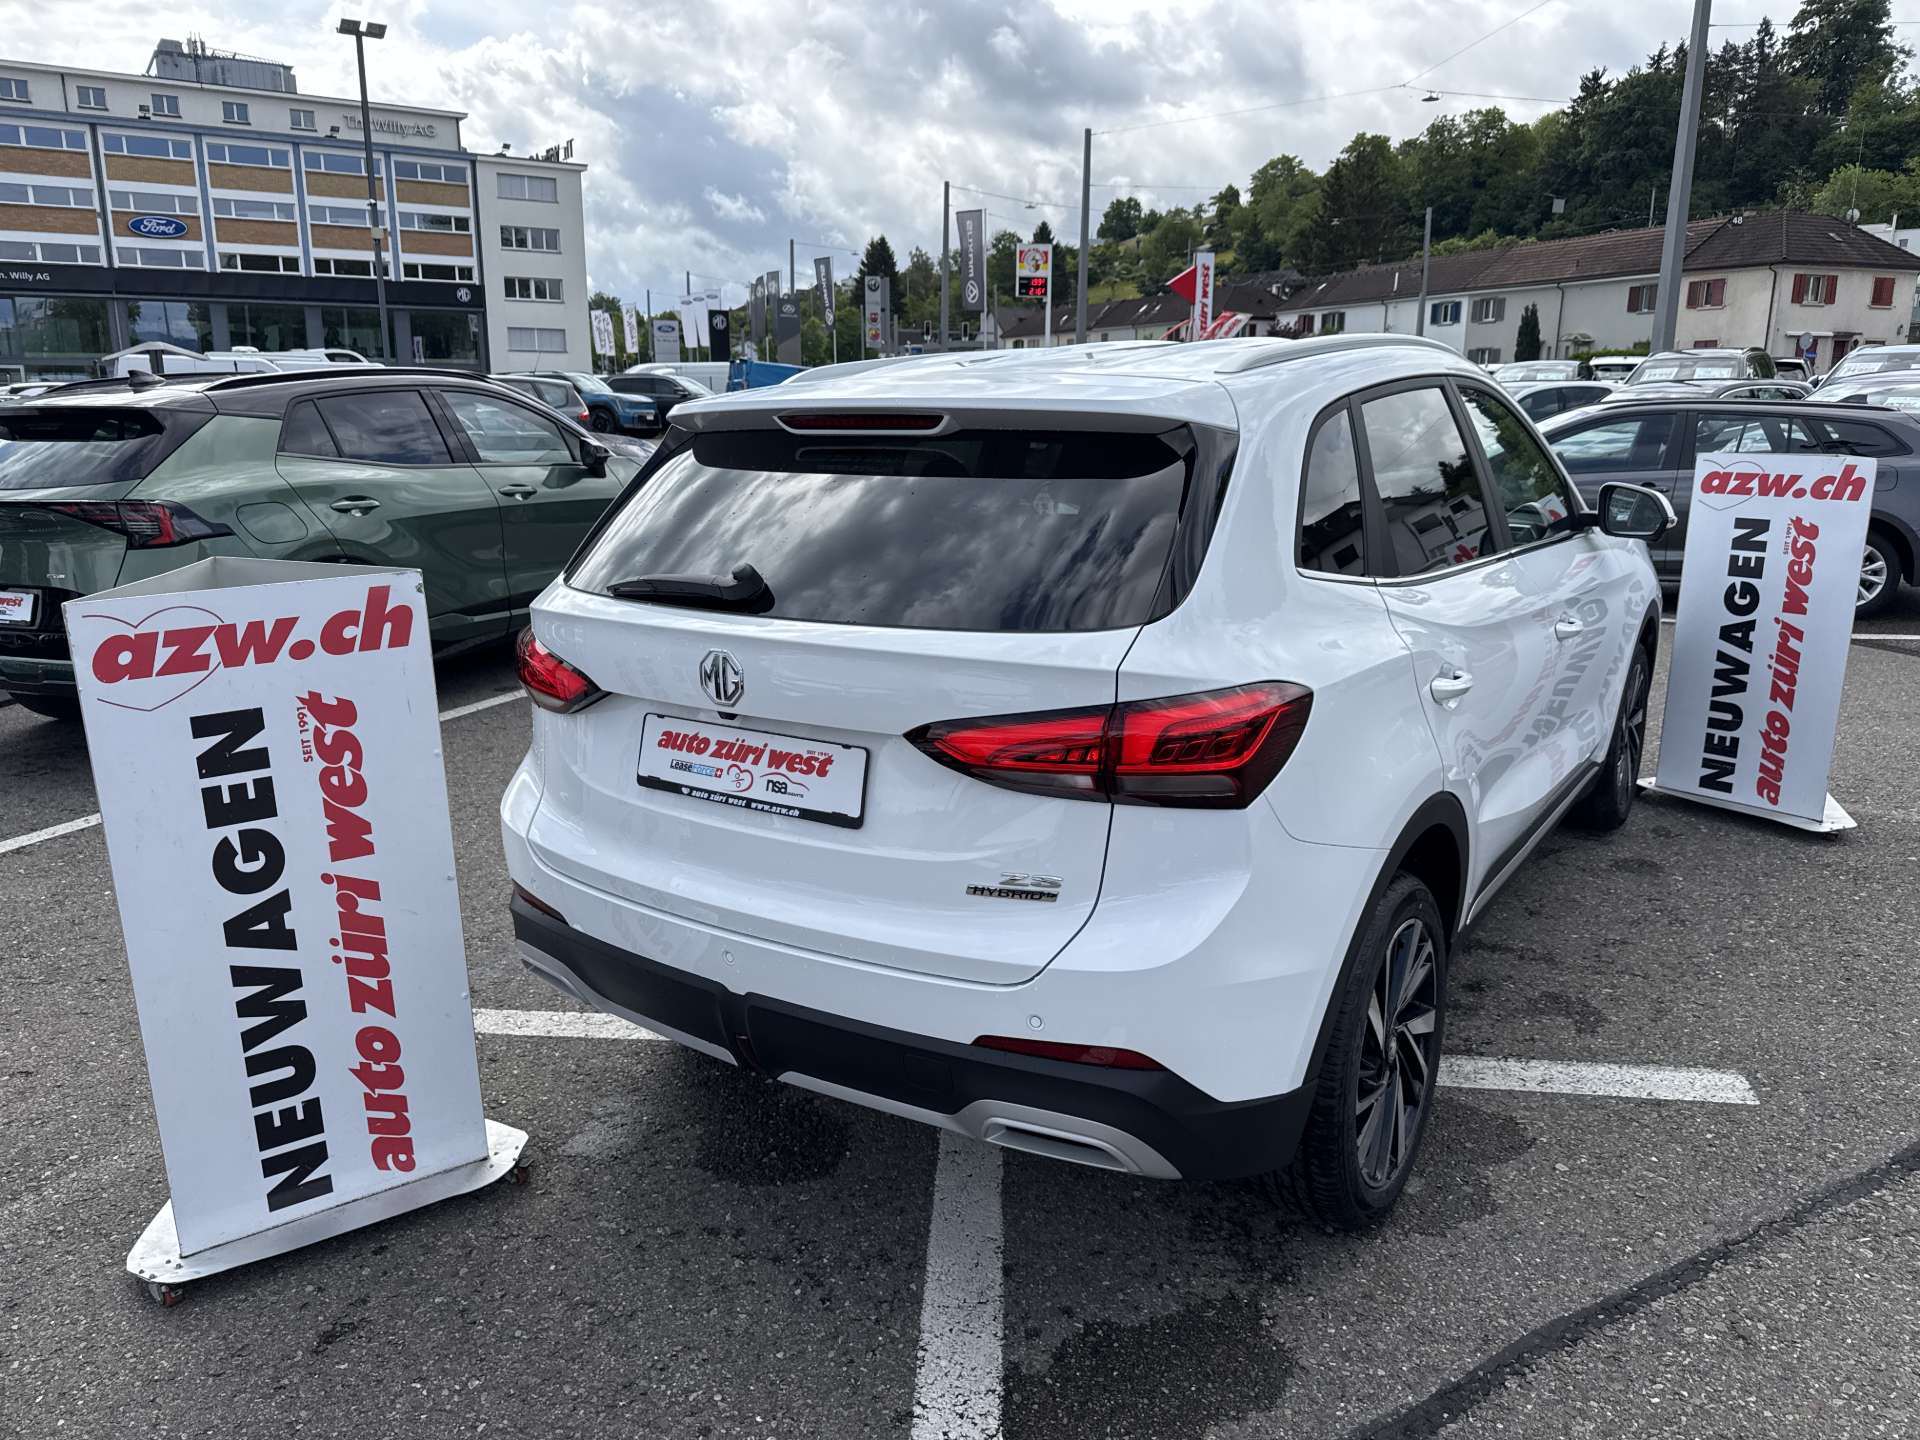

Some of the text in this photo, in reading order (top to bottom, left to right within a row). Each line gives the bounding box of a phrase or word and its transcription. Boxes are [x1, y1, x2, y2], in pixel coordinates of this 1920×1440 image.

[372, 118, 409, 137] Willy
[414, 122, 437, 137] AG
[140, 218, 175, 234] Ford
[1732, 216, 1743, 225] 48
[9, 271, 34, 282] Willy
[36, 272, 50, 281] AG
[1700, 464, 1867, 502] azw.ch
[92, 585, 413, 684] azw.ch
[1698, 517, 1771, 794] NEUWAGEN
[701, 651, 744, 704] MG
[1756, 516, 1819, 806] auto züri west
[297, 706, 313, 762] SEIT 1991
[657, 730, 834, 777] auto züri west
[692, 787, 800, 818] auto züri west www.azw.ch
[766, 779, 788, 794] nsa
[999, 872, 1064, 888] ZS
[295, 690, 415, 1173] auto züri west
[190, 706, 333, 1212] NEUWAGEN
